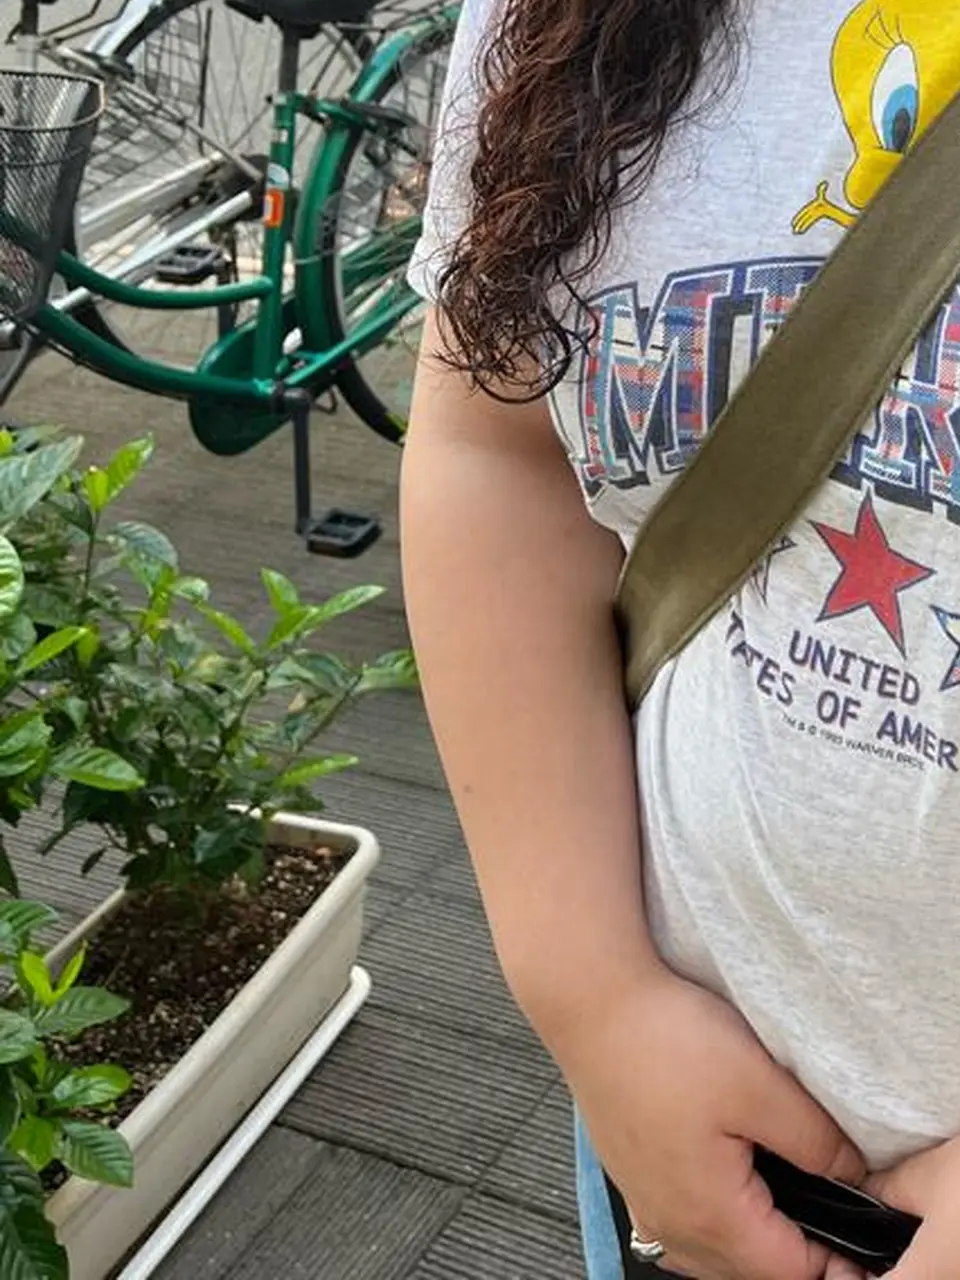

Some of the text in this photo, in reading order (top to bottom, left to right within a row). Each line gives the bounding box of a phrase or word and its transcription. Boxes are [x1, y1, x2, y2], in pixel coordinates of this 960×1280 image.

[789, 630, 920, 706] UNITED
[816, 690, 861, 728] OF
[845, 738, 894, 762] WARNER
